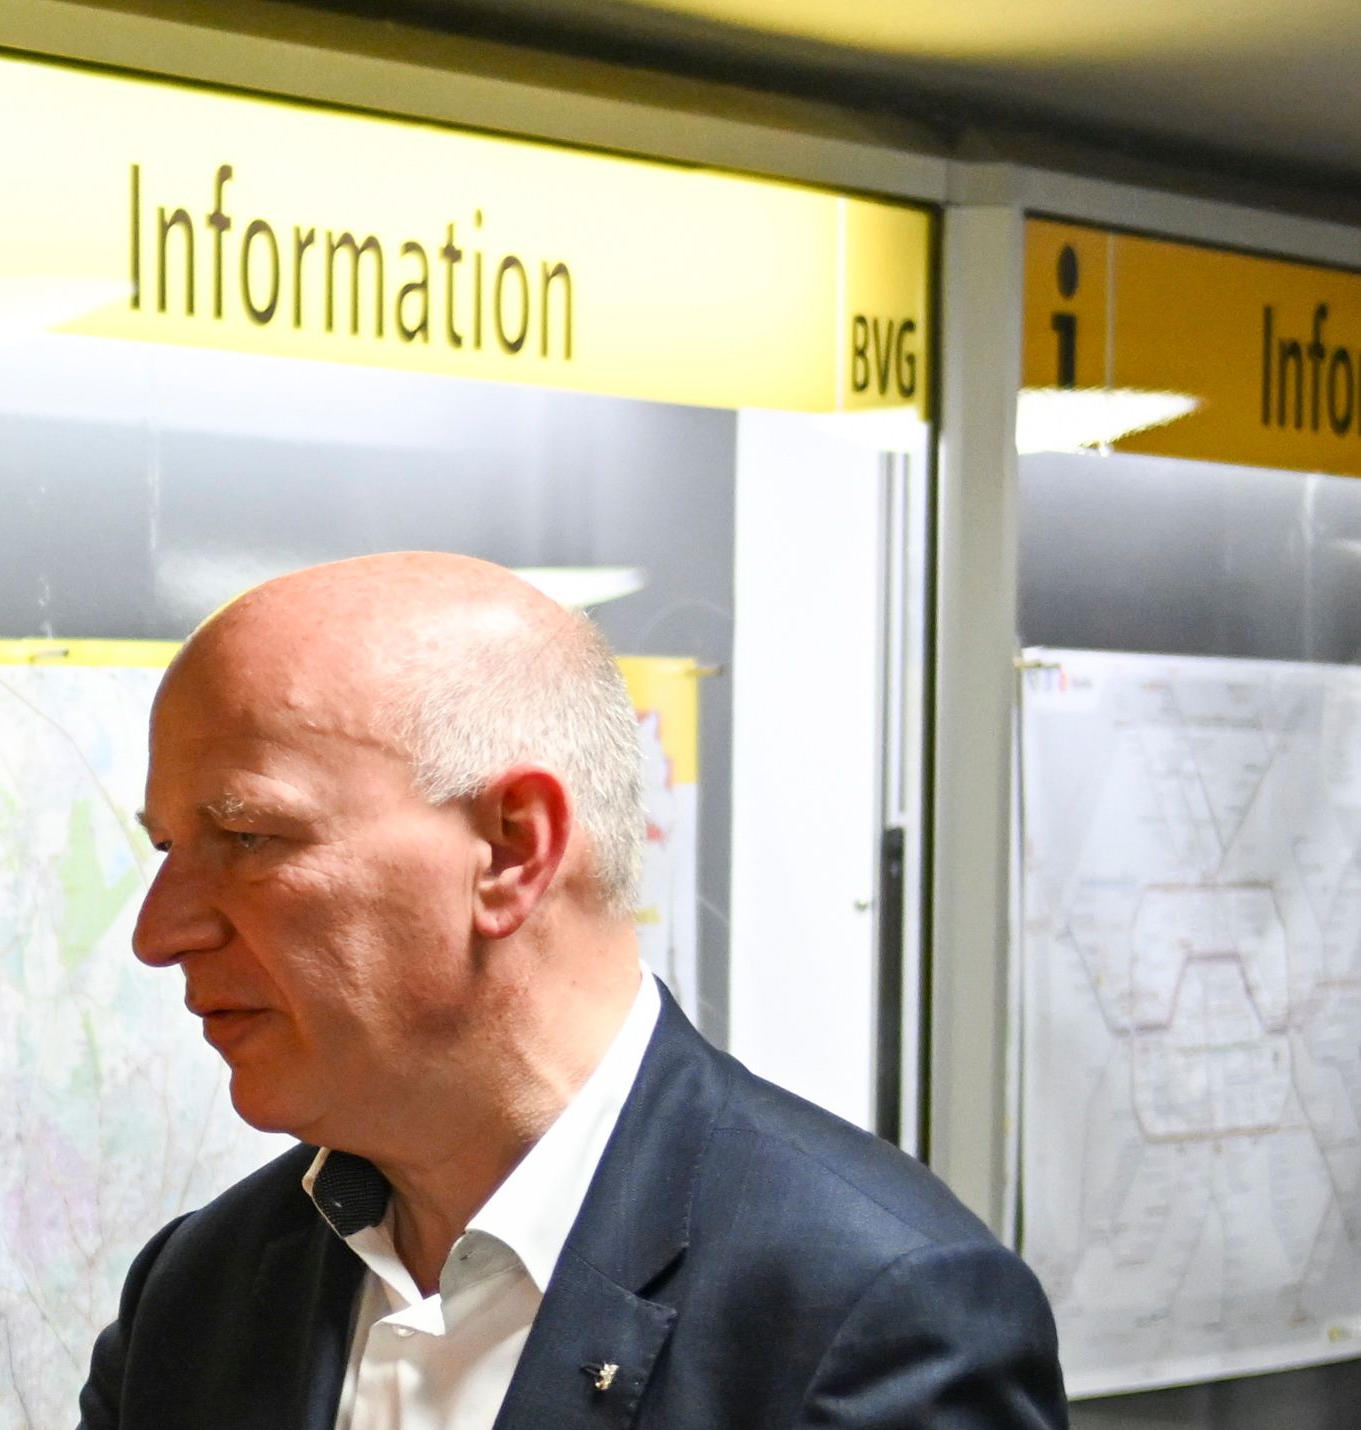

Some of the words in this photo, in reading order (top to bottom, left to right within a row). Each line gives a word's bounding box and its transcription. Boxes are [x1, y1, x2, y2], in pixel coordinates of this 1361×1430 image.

[129, 164, 573, 361] Information
[852, 314, 916, 399] BVG
[1261, 302, 1361, 438] Info
